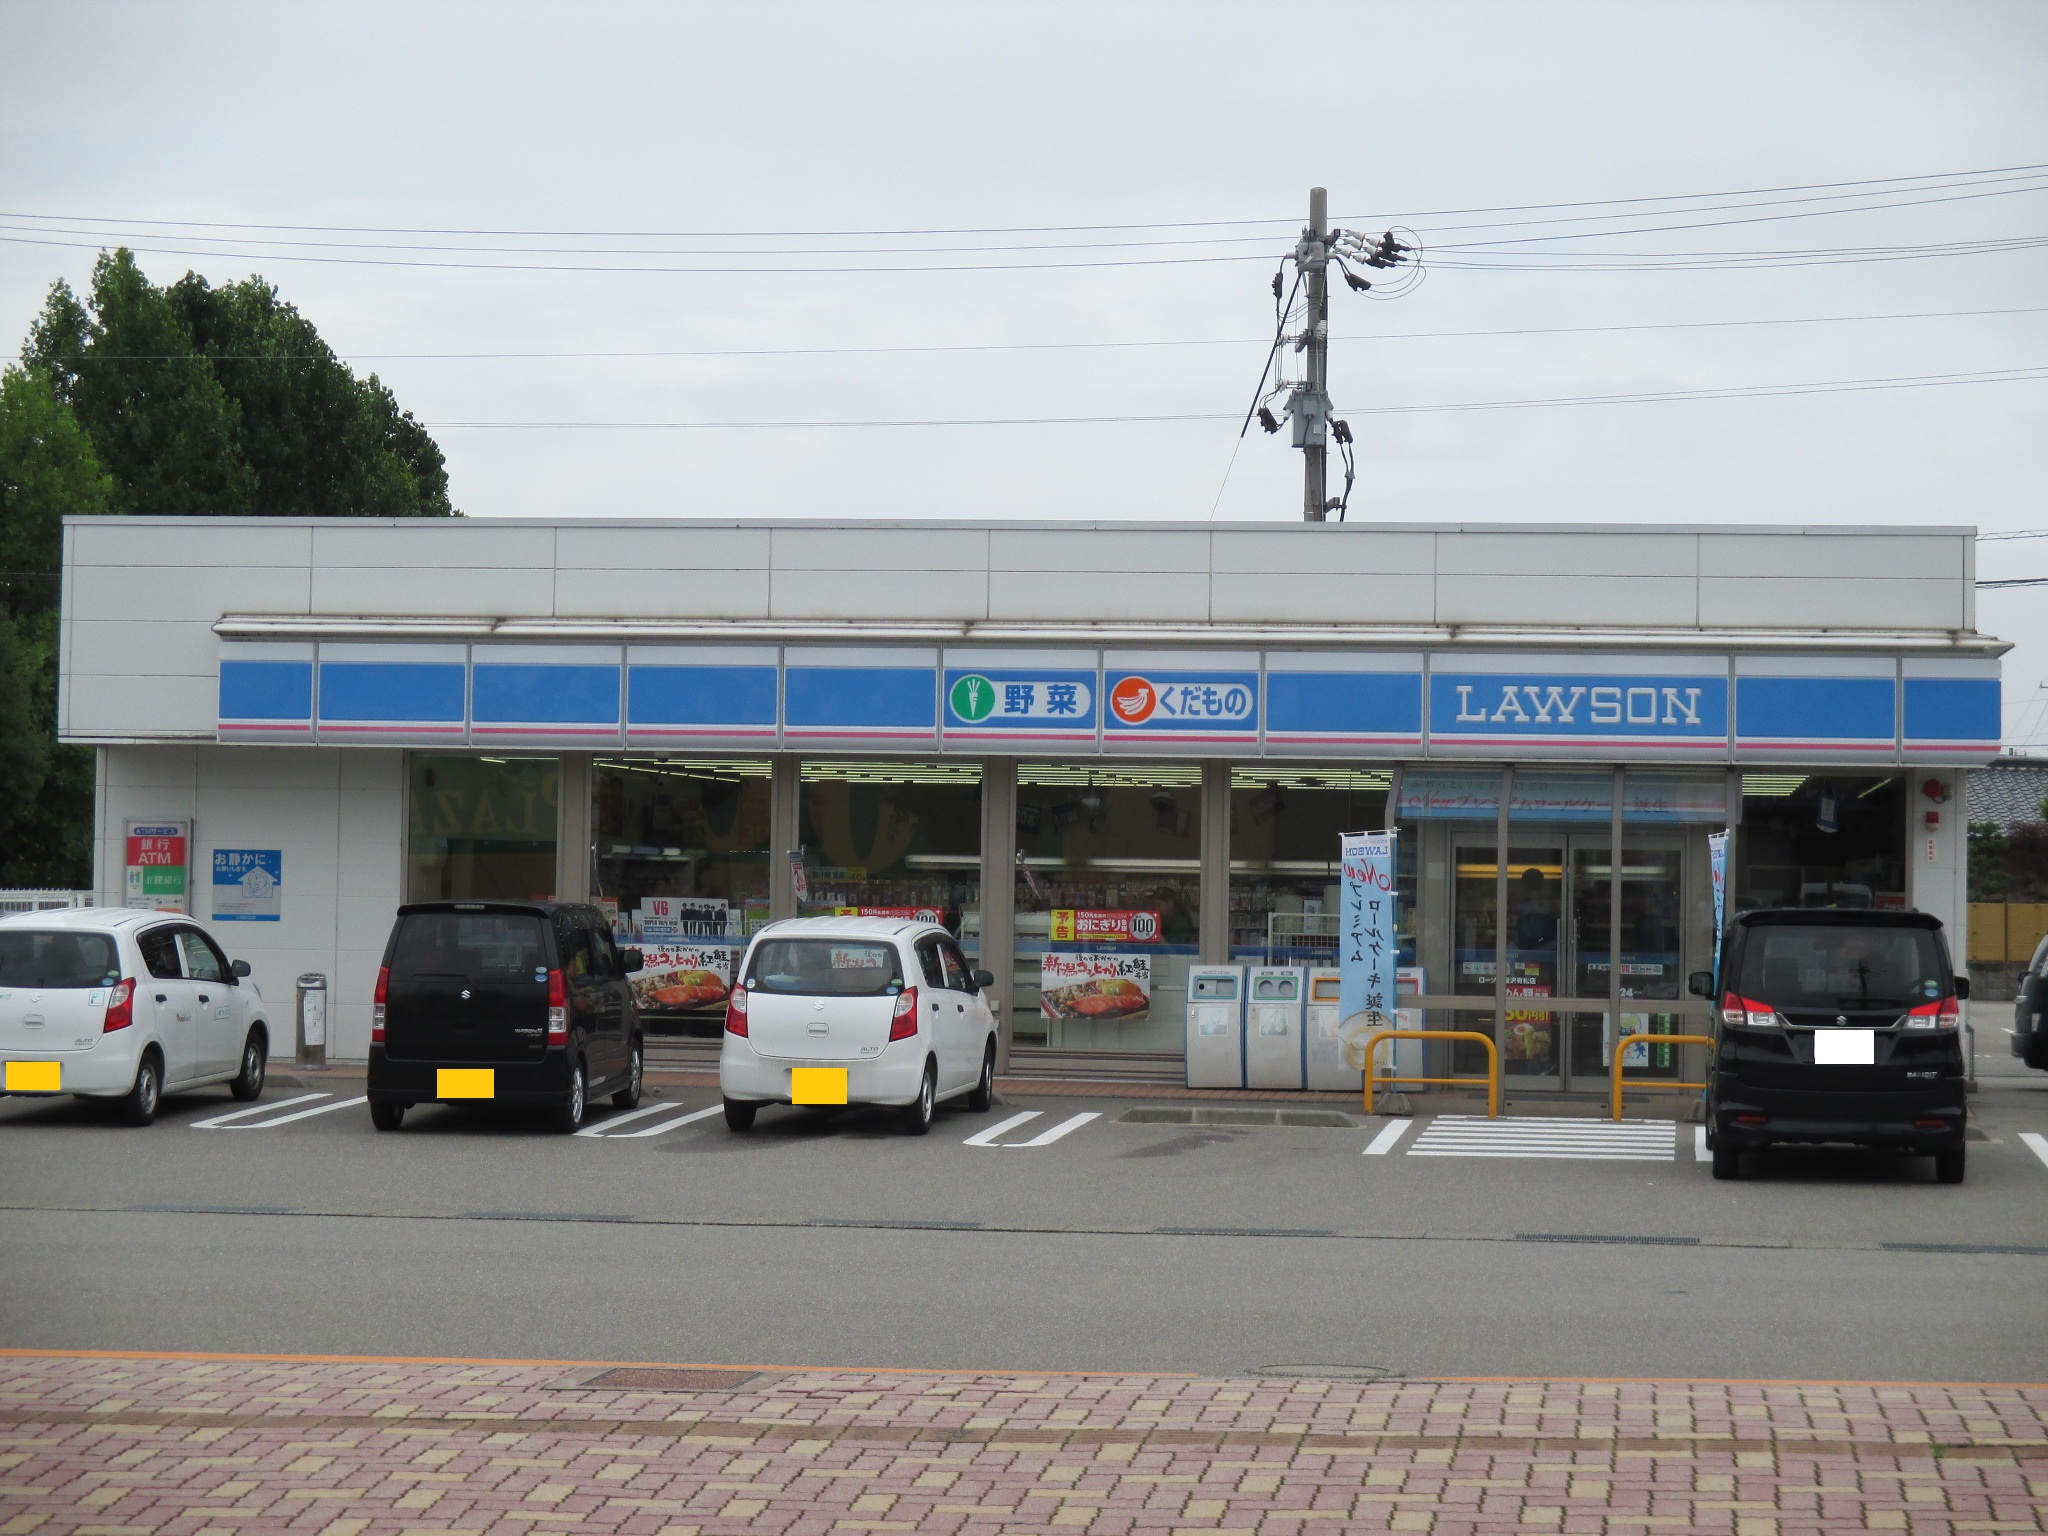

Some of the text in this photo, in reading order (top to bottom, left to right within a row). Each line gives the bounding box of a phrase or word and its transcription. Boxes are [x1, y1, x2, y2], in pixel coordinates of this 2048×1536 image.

[1004, 684, 1077, 715] 野菜
[1160, 686, 1247, 716] くだもの
[1456, 685, 1701, 725] LAWSON
[141, 838, 170, 850] 銀行
[138, 852, 171, 864] ATM
[215, 853, 266, 866] お静かに
[652, 900, 669, 916] V6
[1056, 911, 1069, 939] 予告
[1077, 919, 1121, 931] おにぎり
[1132, 918, 1154, 932] 100
[1620, 987, 1633, 998] 24
